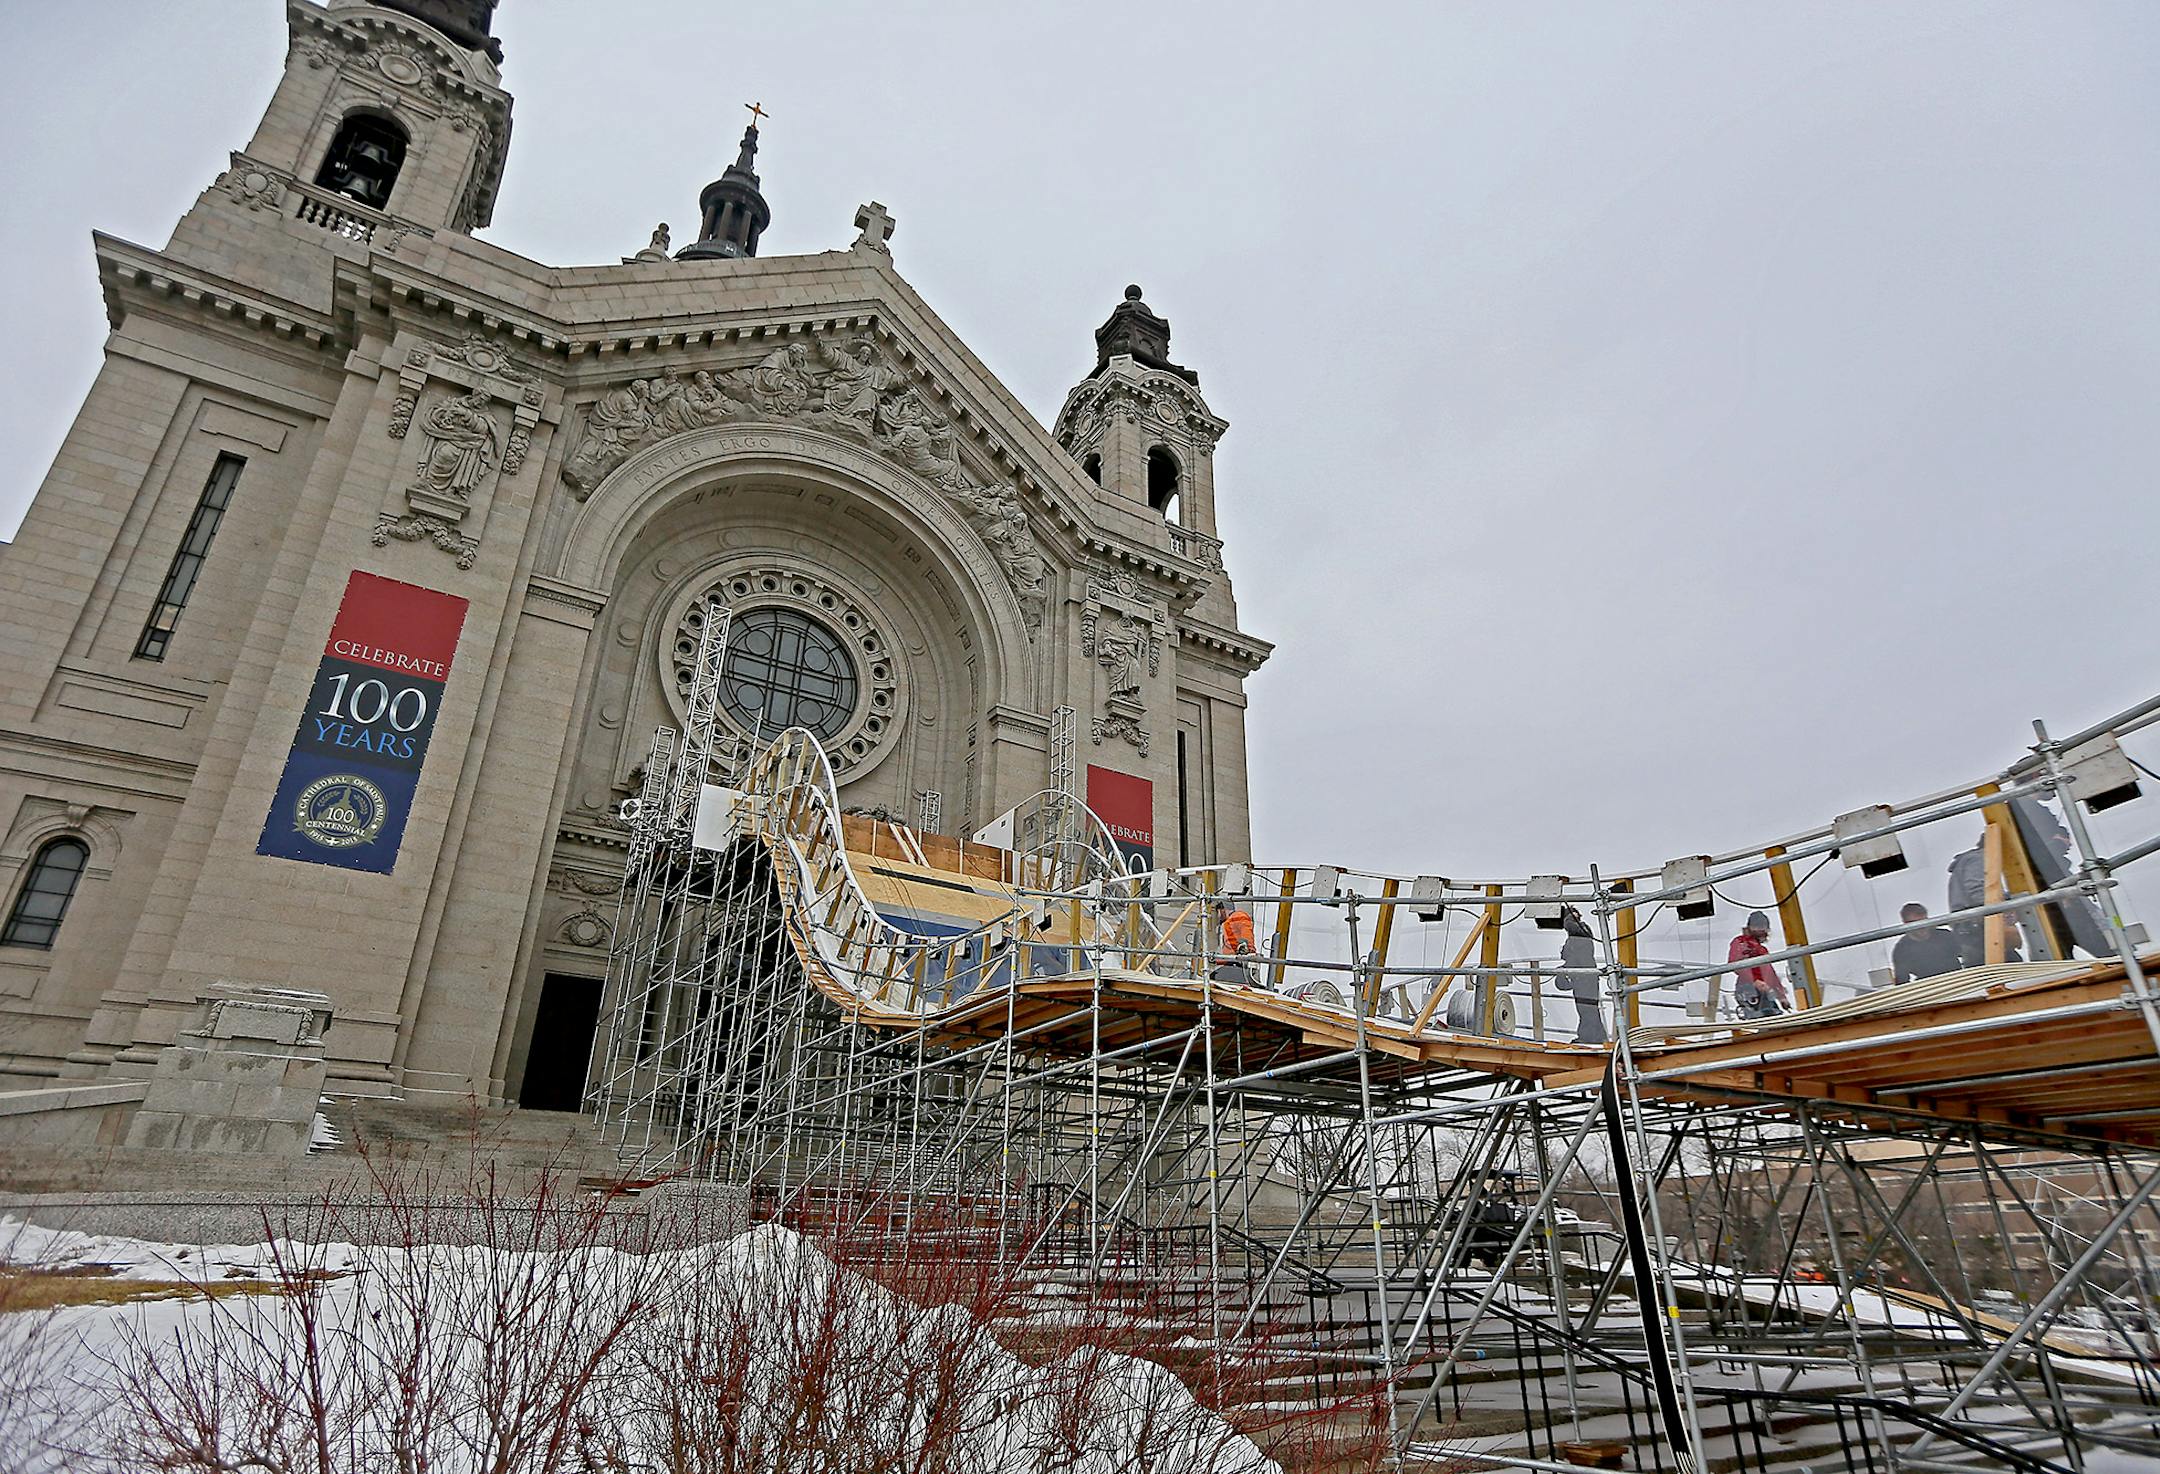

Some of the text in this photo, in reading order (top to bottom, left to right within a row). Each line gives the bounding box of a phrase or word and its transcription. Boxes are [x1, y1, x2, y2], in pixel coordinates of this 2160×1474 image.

[634, 446, 702, 487] EVNTES
[719, 437, 771, 450] ERGO
[892, 480, 945, 526] OMNES
[955, 536, 1000, 601] GENTES
[334, 640, 445, 677] CELEBRATE
[319, 673, 427, 732] 100
[315, 718, 416, 758] YEARS
[300, 776, 347, 809] CATHEDRAL
[353, 779, 366, 787] OF
[364, 784, 383, 804] SAINT
[305, 820, 366, 837] CENTENNIAL
[326, 807, 354, 823] 100
